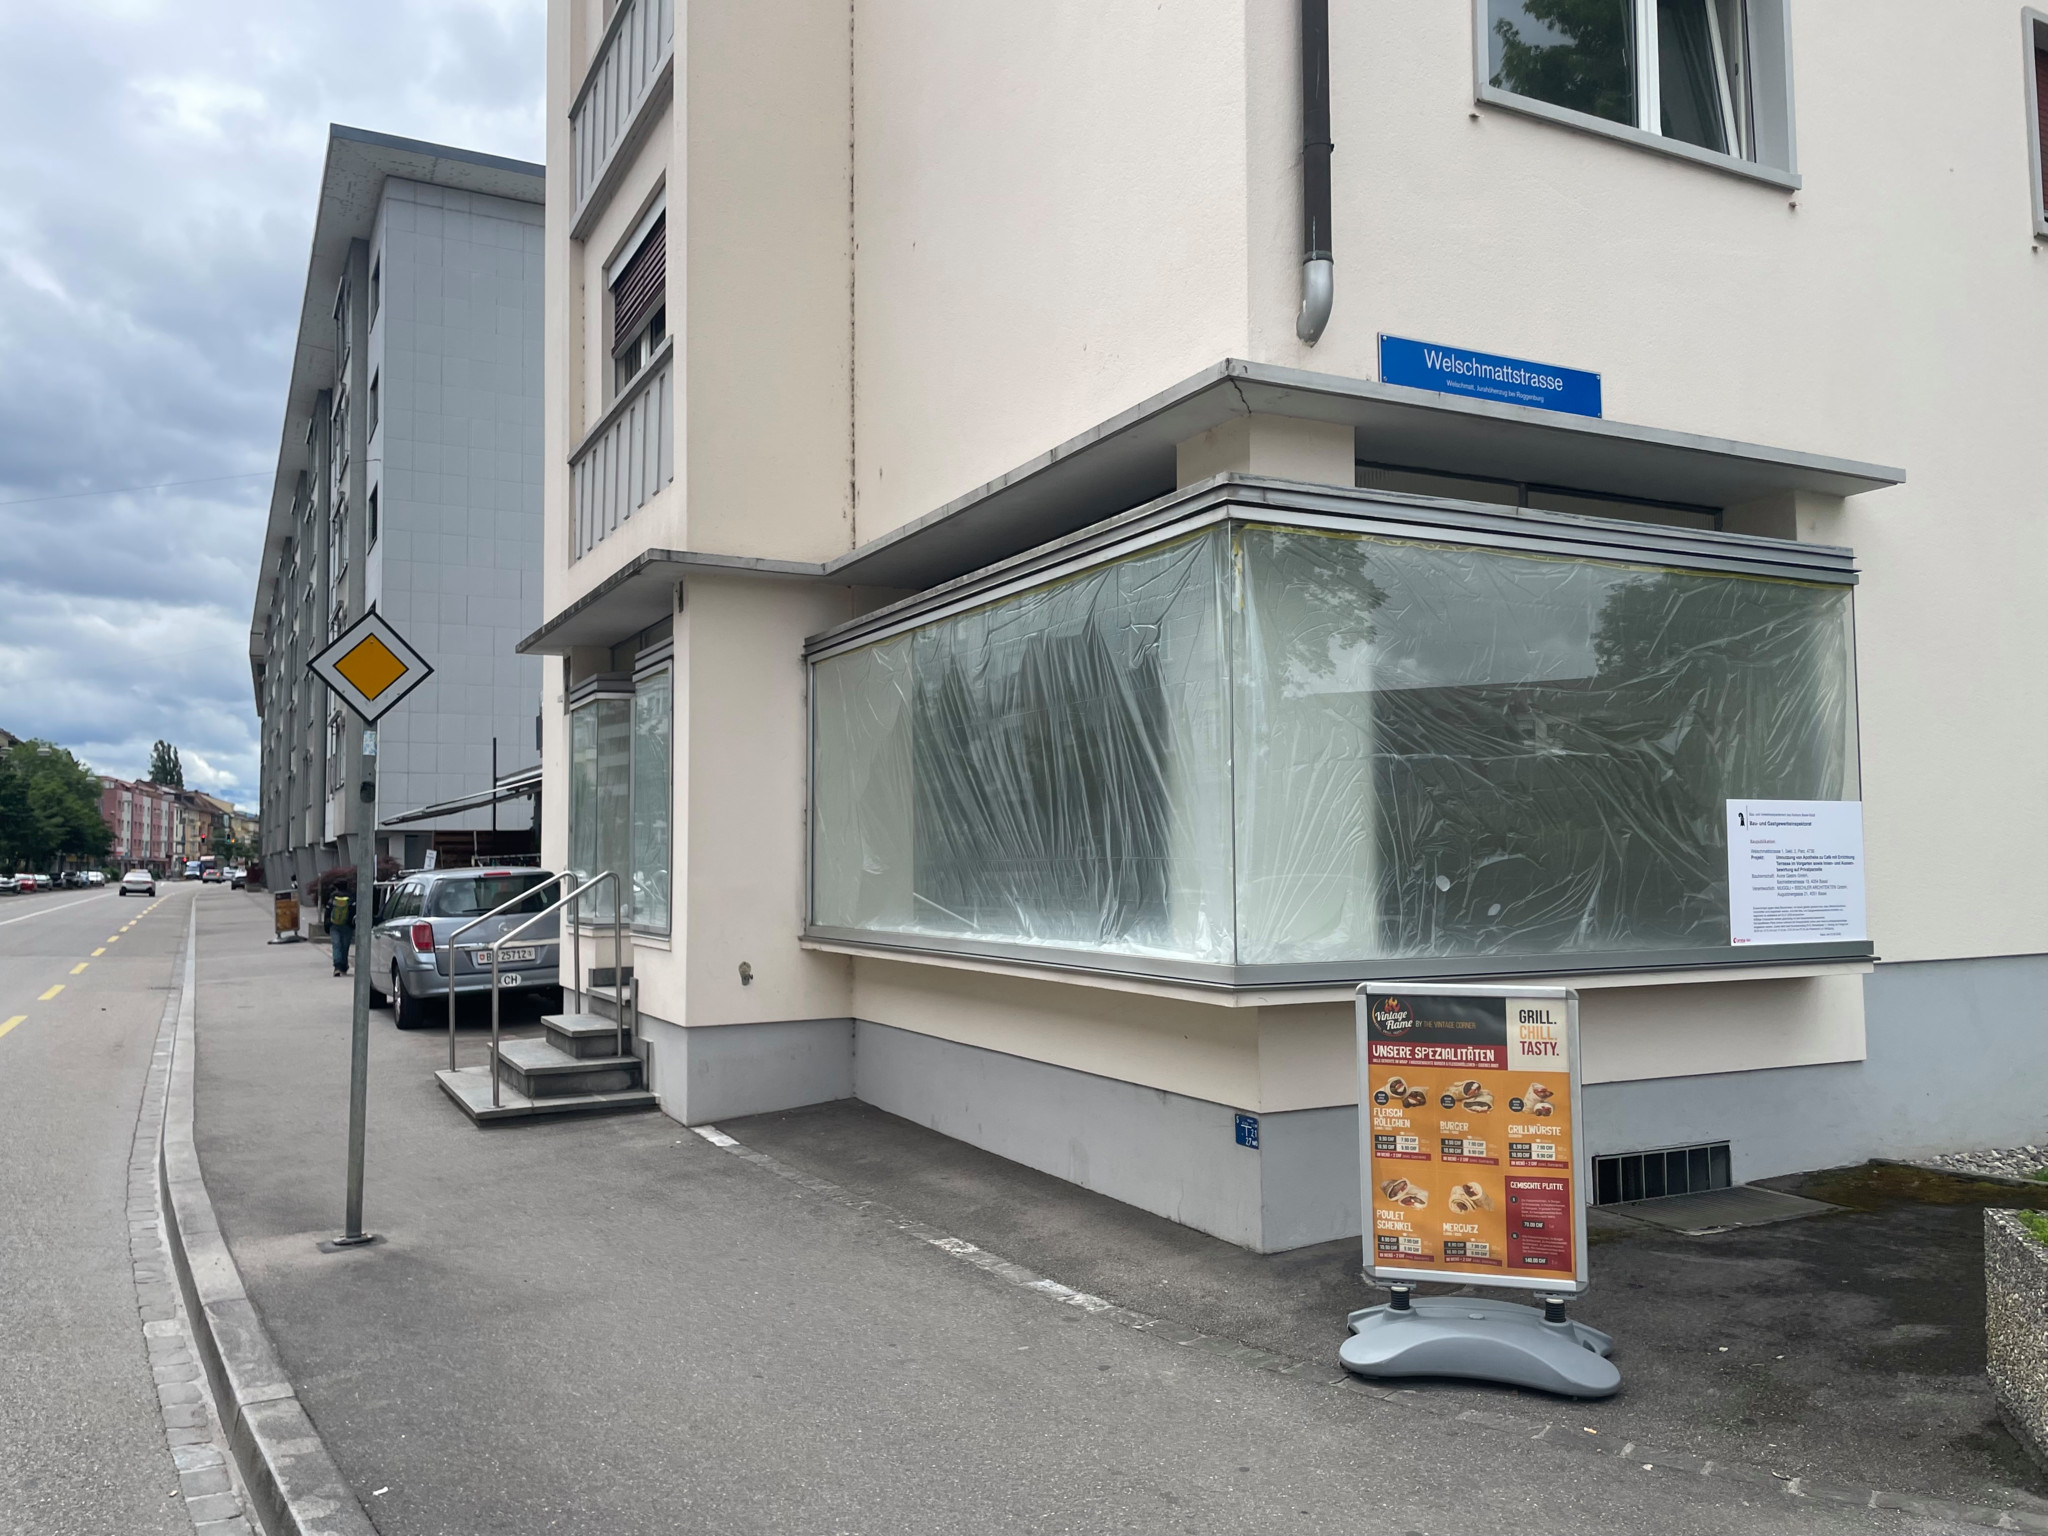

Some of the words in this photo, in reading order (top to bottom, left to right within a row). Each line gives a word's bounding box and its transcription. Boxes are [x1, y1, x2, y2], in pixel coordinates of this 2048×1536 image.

[1424, 348, 1563, 391] Welschmattstrasse
[501, 949, 527, 961] 25712
[503, 975, 518, 985] CH
[1375, 1011, 1408, 1022] Vintage
[1519, 1009, 1557, 1024] GRILL.
[1386, 1020, 1414, 1030] Flame
[1415, 1020, 1423, 1028] BY
[1424, 1021, 1433, 1029] THE
[1433, 1021, 1455, 1029] VINTAGE
[1456, 1021, 1476, 1030] CORNER
[1520, 1025, 1558, 1040] CHILL.
[1372, 1044, 1413, 1059] UNSERE
[1414, 1046, 1495, 1062] SPEZIALITÄTEN
[1520, 1041, 1560, 1056] TASTY.
[1373, 1107, 1403, 1117] FLEISCH
[1374, 1117, 1410, 1128] RÖLLCHEN
[1440, 1121, 1469, 1132] BURGER
[1508, 1124, 1561, 1136] GRILLWÜRSTE
[1510, 1181, 1541, 1190] GEMISCHTE
[1542, 1182, 1563, 1191] PLATTE
[1377, 1209, 1404, 1220] POULET
[1377, 1220, 1413, 1231] SCHENKEL
